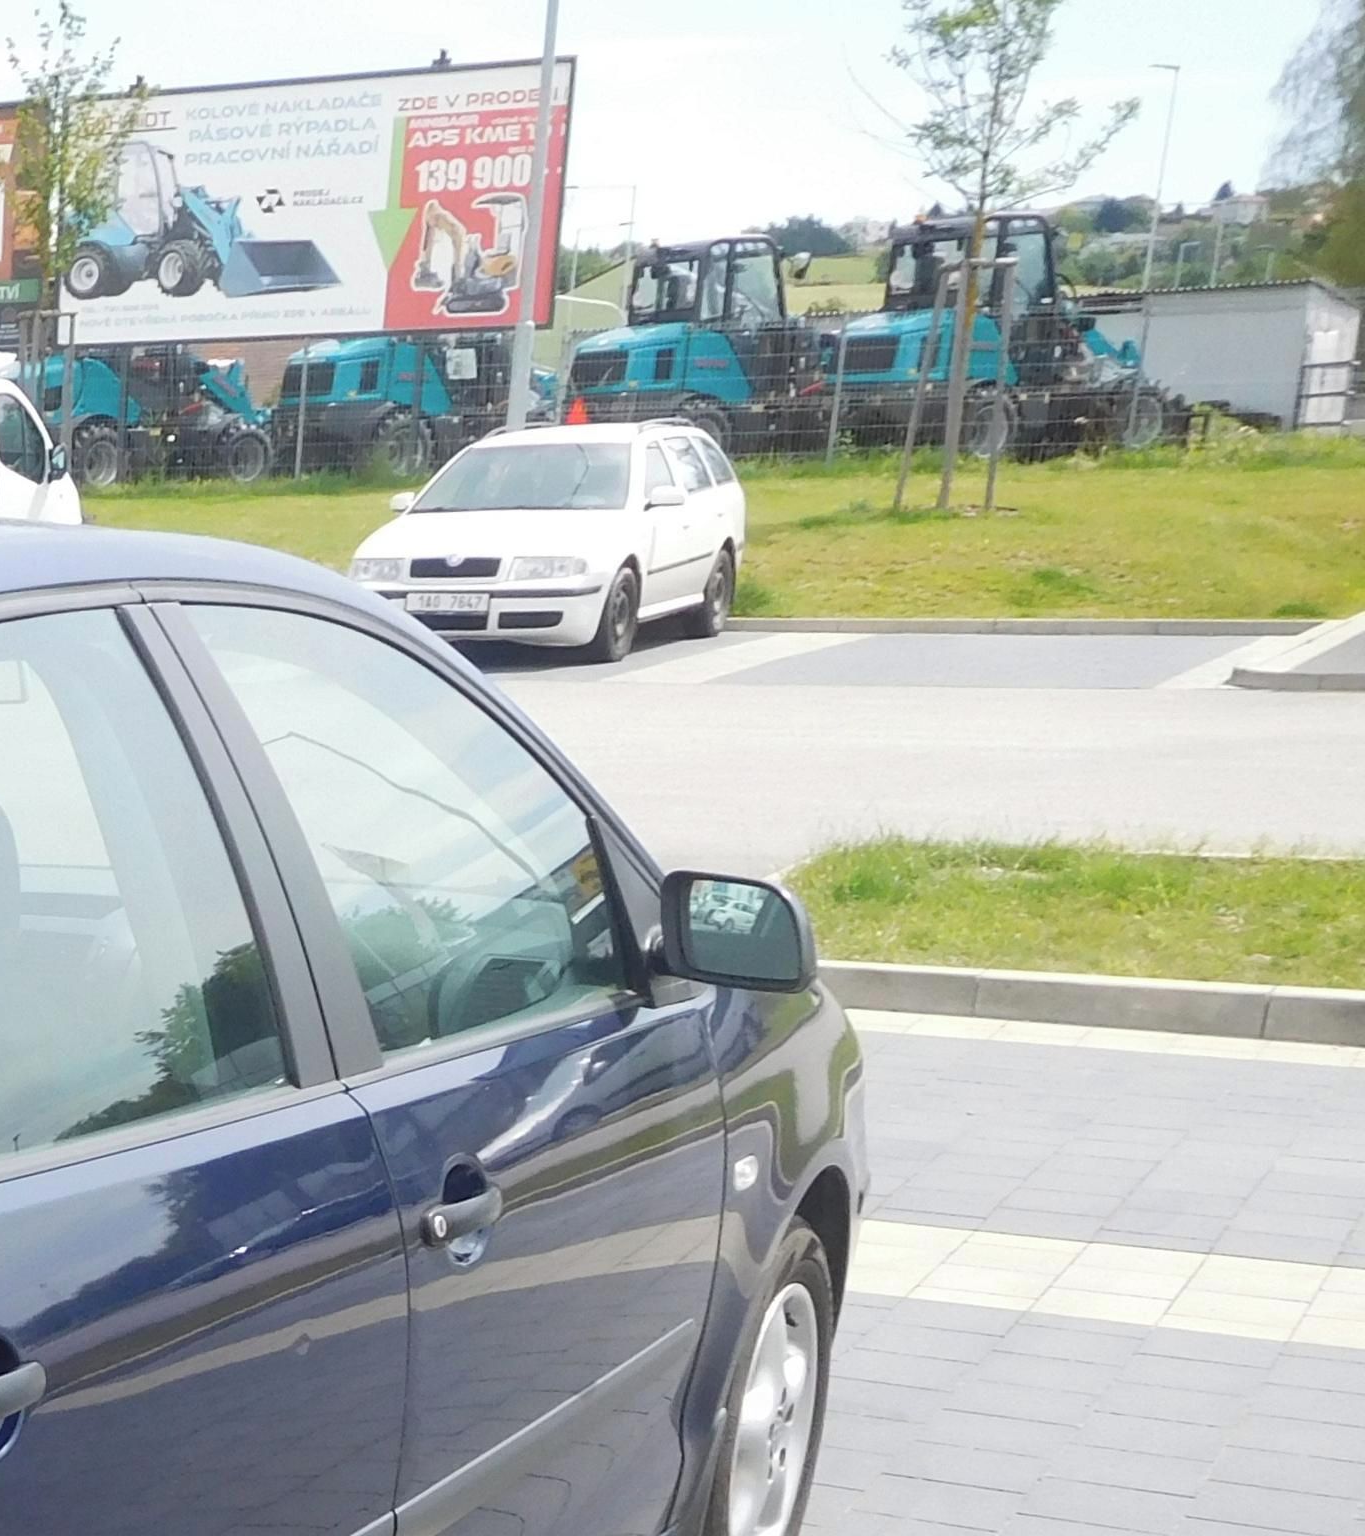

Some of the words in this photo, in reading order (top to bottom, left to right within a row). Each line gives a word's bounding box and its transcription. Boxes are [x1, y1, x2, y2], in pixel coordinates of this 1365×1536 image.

[264, 92, 382, 114] NAKLADAČE
[397, 97, 438, 112] ZDE
[445, 94, 461, 108] V
[188, 119, 273, 142] PÁSOVÉ
[277, 115, 377, 135] RÝPADLA
[407, 128, 461, 148] APS
[465, 124, 520, 144] KME
[183, 145, 291, 167] PRACOVNÍ
[295, 133, 380, 158] NÁŘADÍ
[415, 157, 468, 193] 139
[472, 153, 533, 189] 900
